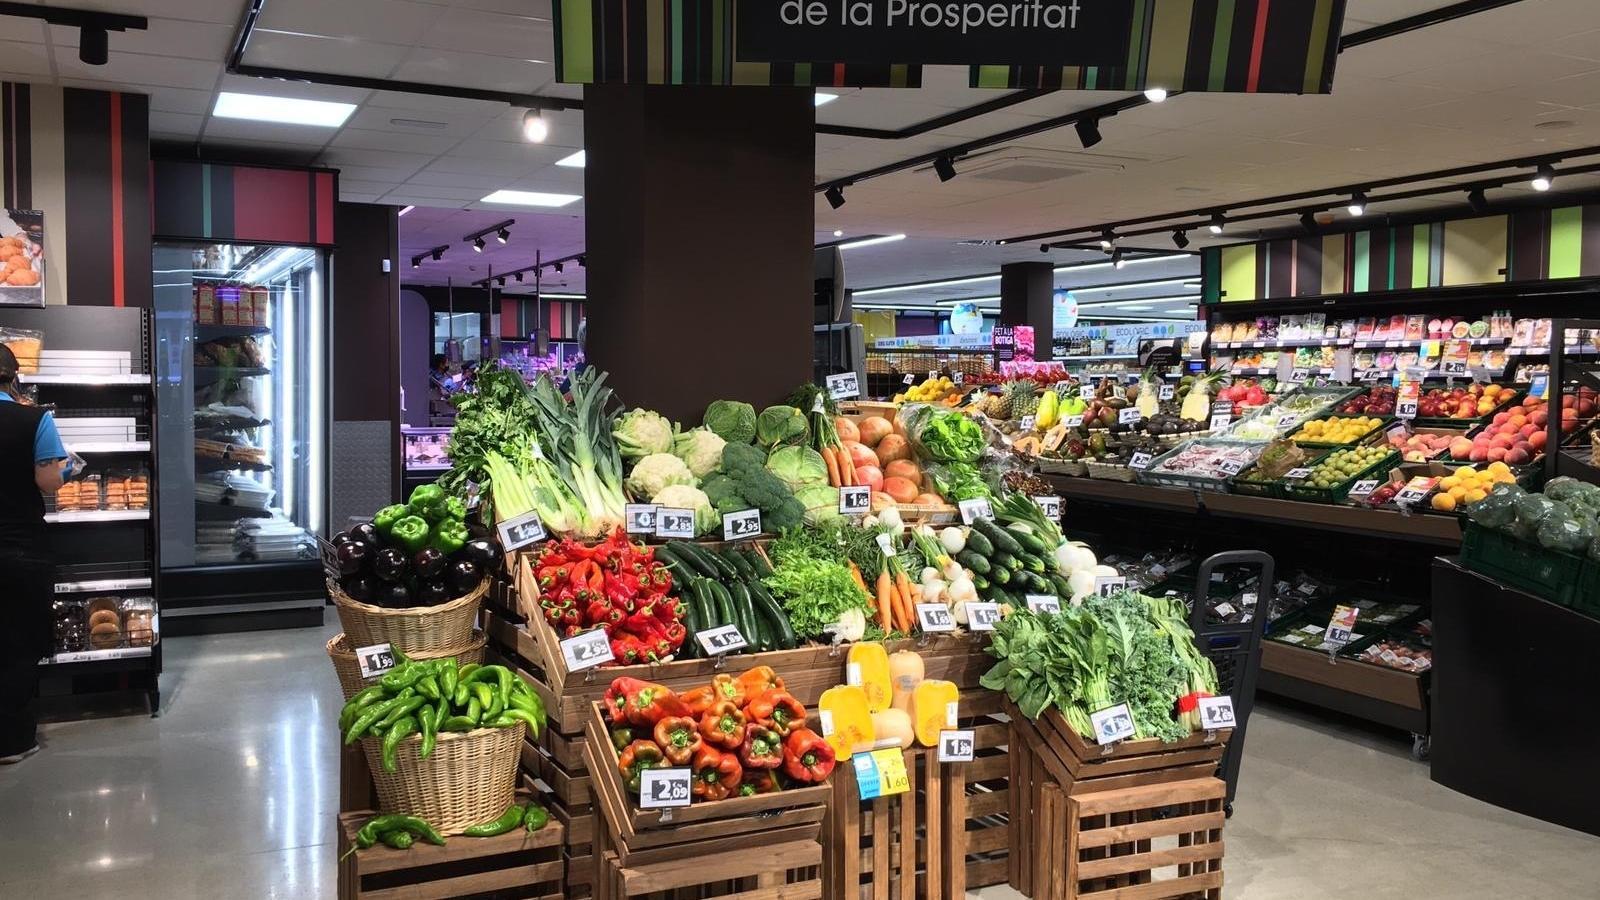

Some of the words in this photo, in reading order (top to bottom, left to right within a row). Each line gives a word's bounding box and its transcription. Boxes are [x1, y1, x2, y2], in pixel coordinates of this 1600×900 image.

[780, 0, 828, 26] de
[841, 0, 873, 26] la
[887, 0, 1081, 34] Prosperitat
[994, 335, 1013, 345] BOTIGA
[658, 779, 688, 802] 2,09
